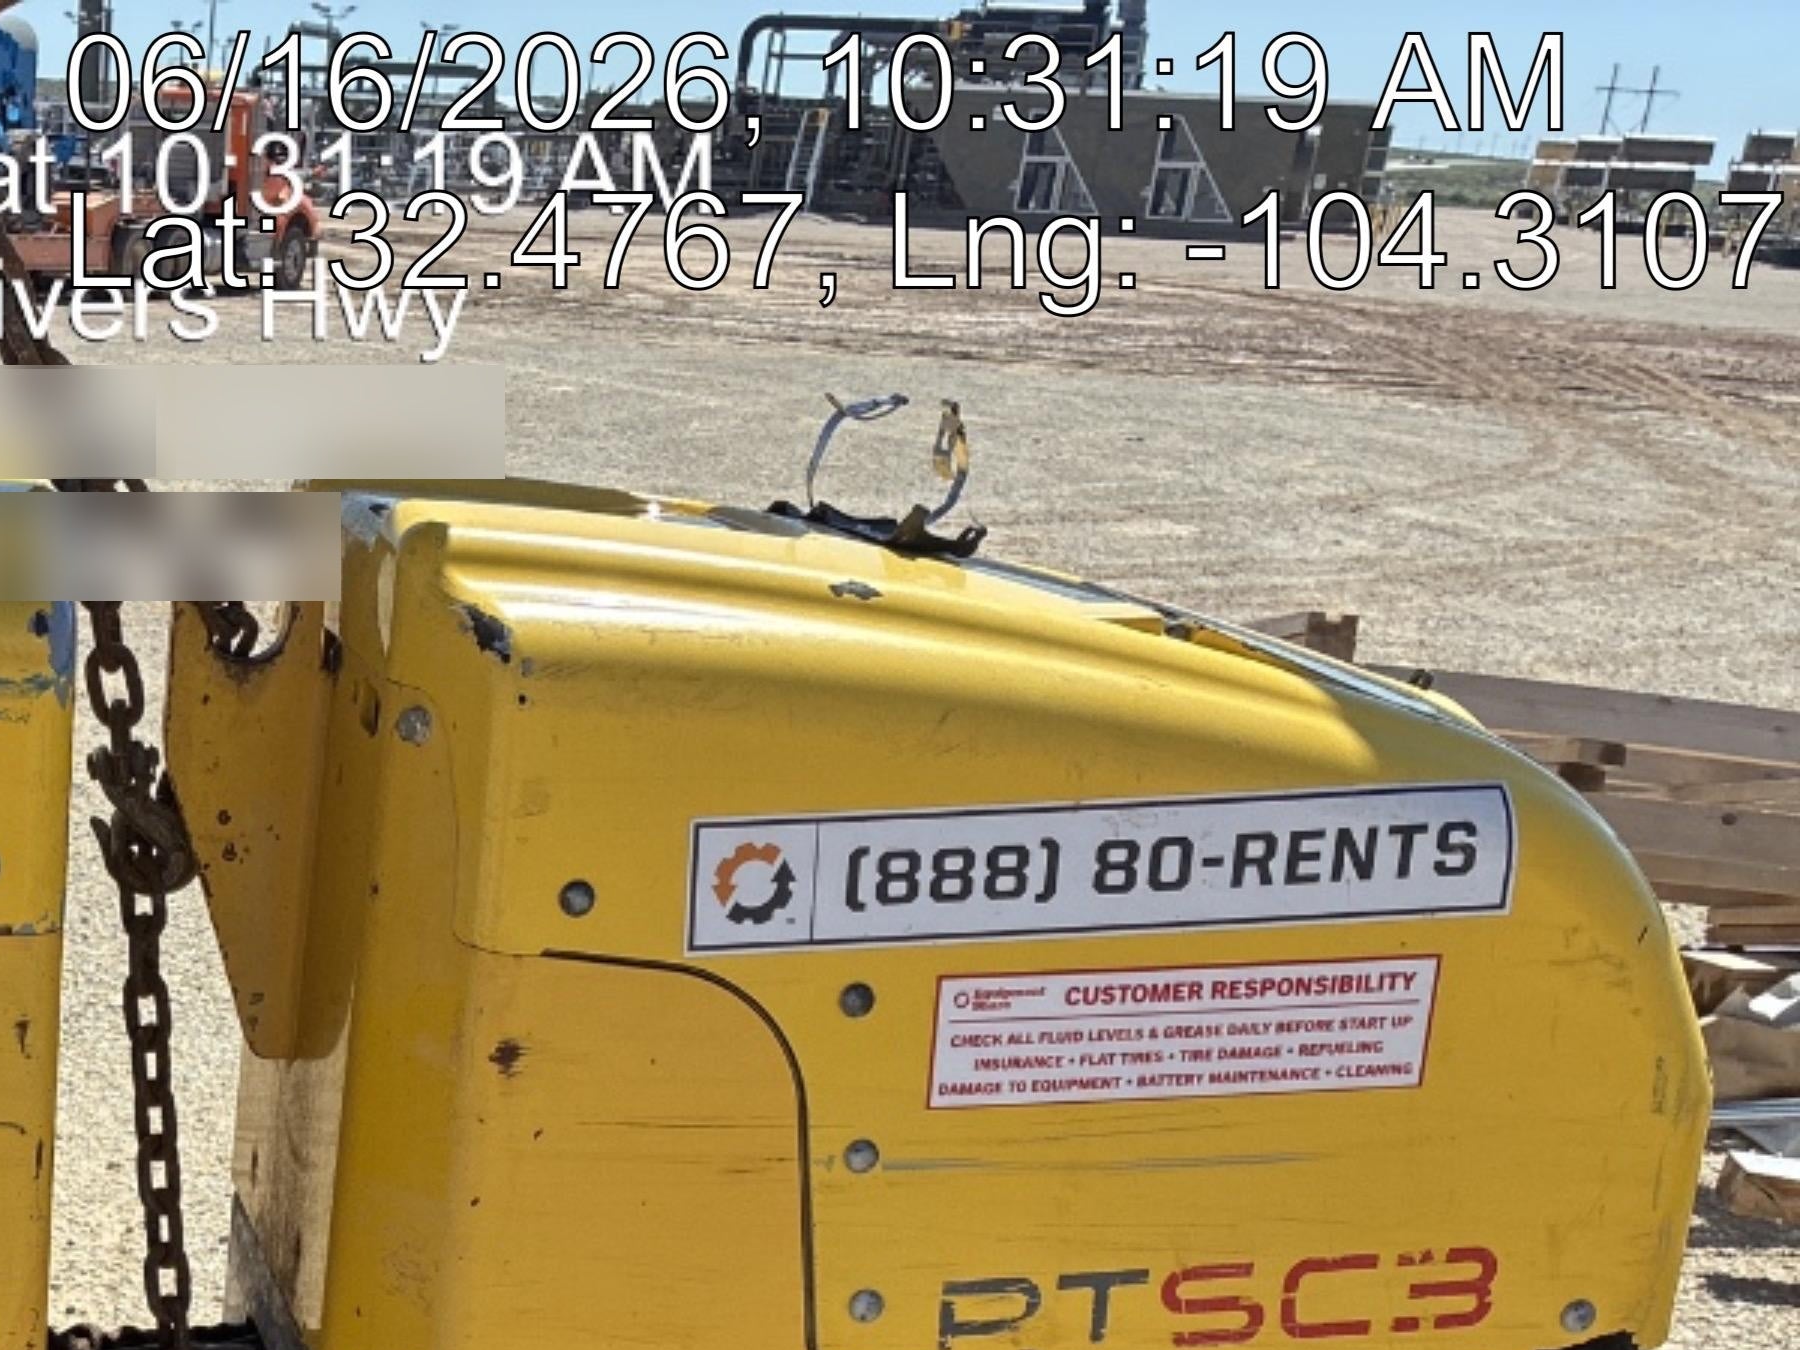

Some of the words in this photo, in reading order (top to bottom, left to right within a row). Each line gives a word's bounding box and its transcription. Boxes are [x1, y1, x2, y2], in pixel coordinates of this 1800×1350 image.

[845, 837, 1060, 911] (888)
[1092, 820, 1479, 895] 80-RENTS
[1064, 980, 1203, 1006] CUSTOMER
[1211, 972, 1417, 1000] RESPONSIBILITY
[951, 1032, 1002, 1048] CHECK
[1007, 1031, 1034, 1045] ALL
[1038, 1029, 1083, 1045] FLUID
[1088, 1027, 1144, 1043] LEVELS
[1149, 1026, 1158, 1039] &
[1163, 1023, 1222, 1040] GREASE
[1227, 1022, 1273, 1036] DAILY
[1275, 1019, 1335, 1034] BEFORE
[1338, 1016, 1387, 1031] START
[1391, 1015, 1414, 1028] UP
[974, 1055, 1065, 1072] INSURANCE
[1079, 1052, 1117, 1067] FLAT
[1120, 1050, 1164, 1066] TIRES
[1179, 1049, 1212, 1063] TIRE
[1217, 1045, 1282, 1061] DAMAGE
[1298, 1040, 1383, 1057] REFUELING
[938, 1082, 1001, 1097] DAMAGE
[1009, 1080, 1026, 1093] TO
[1032, 1076, 1120, 1093] EQUIPMENT
[1136, 1073, 1203, 1088] BATTERY
[1208, 1067, 1321, 1085] MAINTENANCE
[1335, 1062, 1413, 1079] CLEANING
